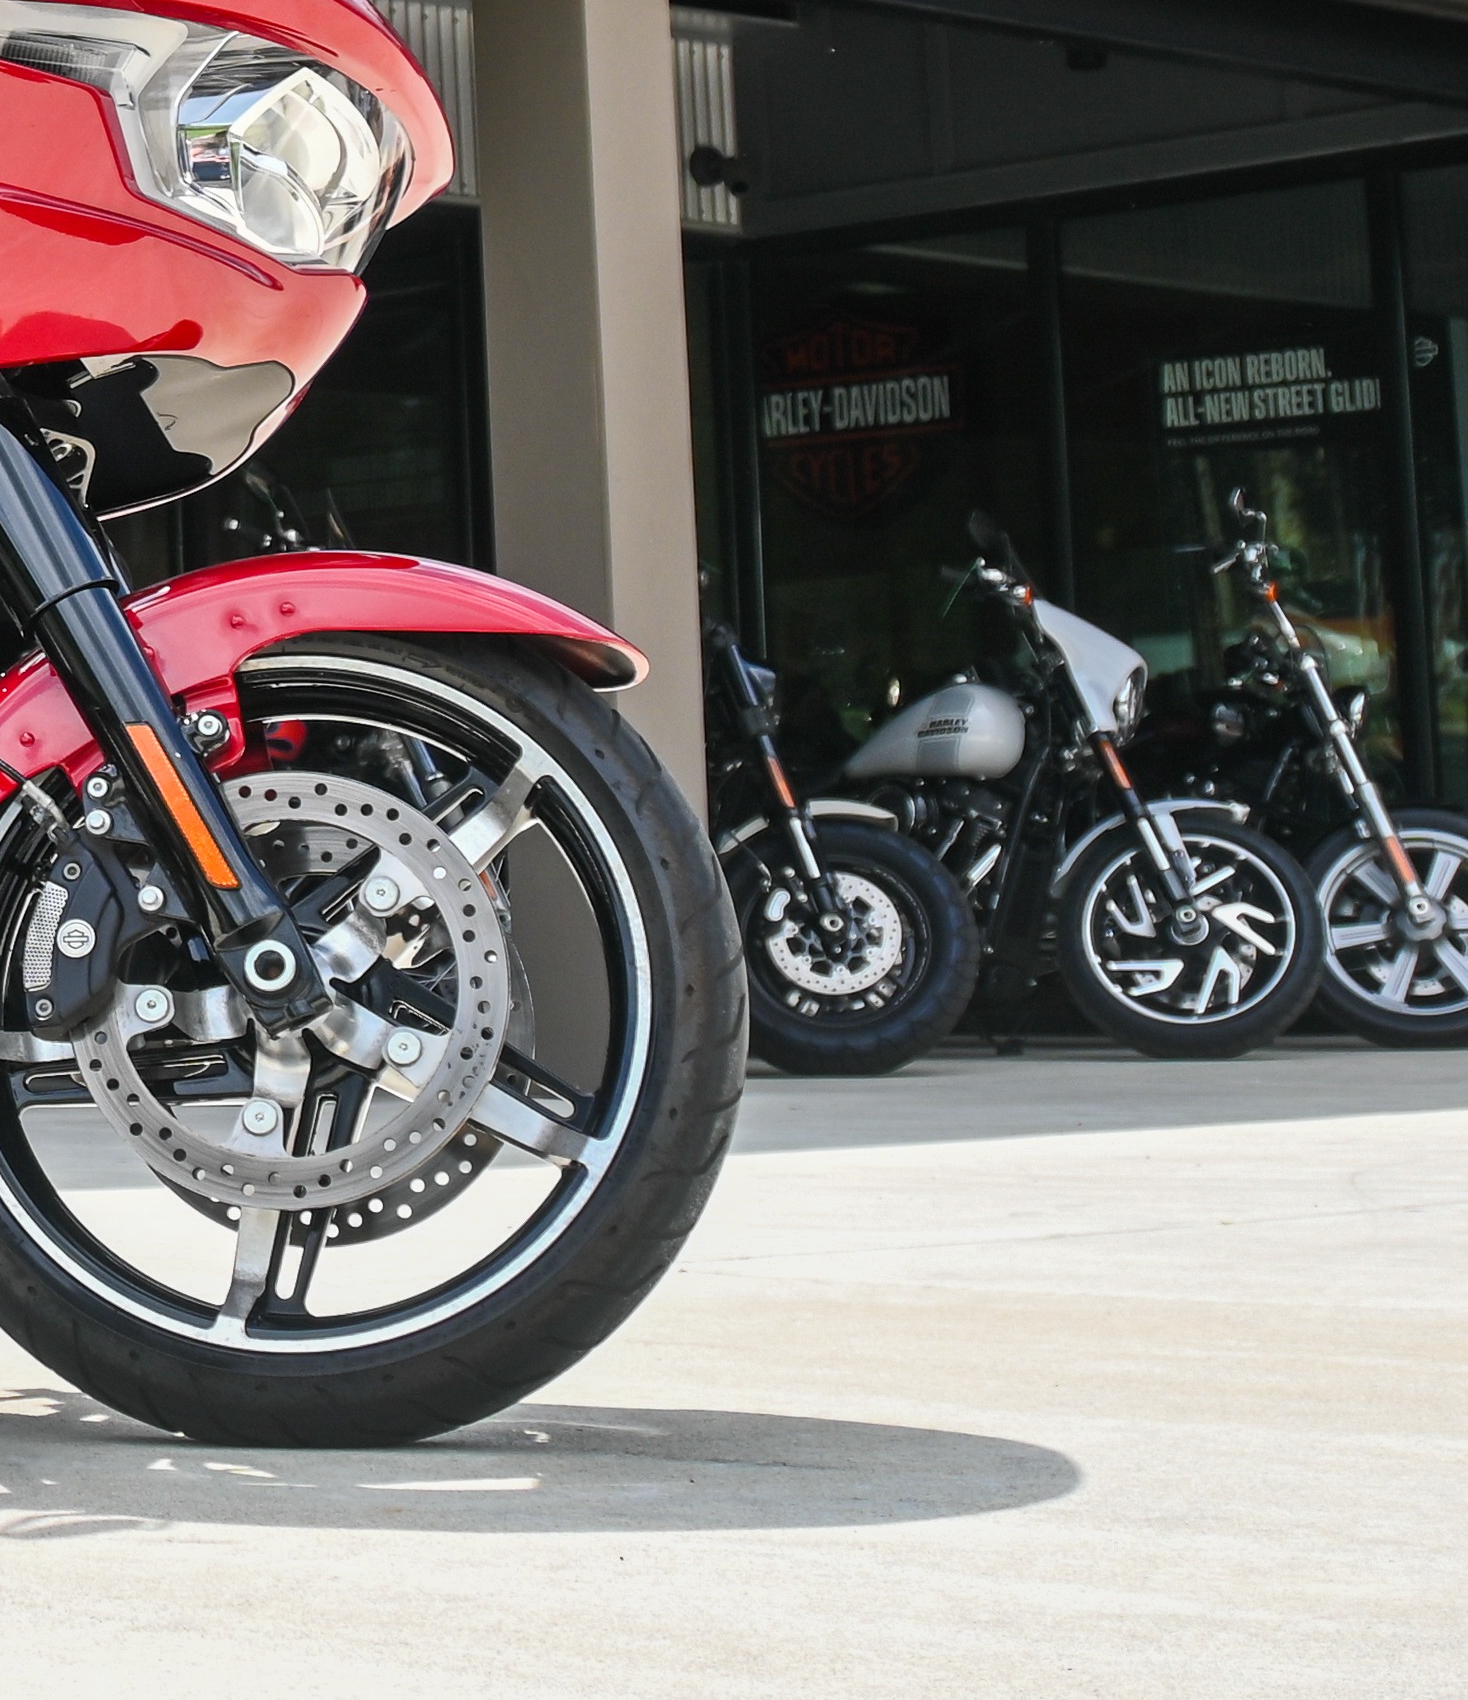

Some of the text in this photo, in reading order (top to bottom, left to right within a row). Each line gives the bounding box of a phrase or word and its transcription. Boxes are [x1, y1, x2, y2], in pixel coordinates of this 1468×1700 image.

[1163, 347, 1333, 394] AN ICON REBORN.
[1166, 390, 1251, 429] ALL-NEW
[1254, 381, 1327, 421] STREET
